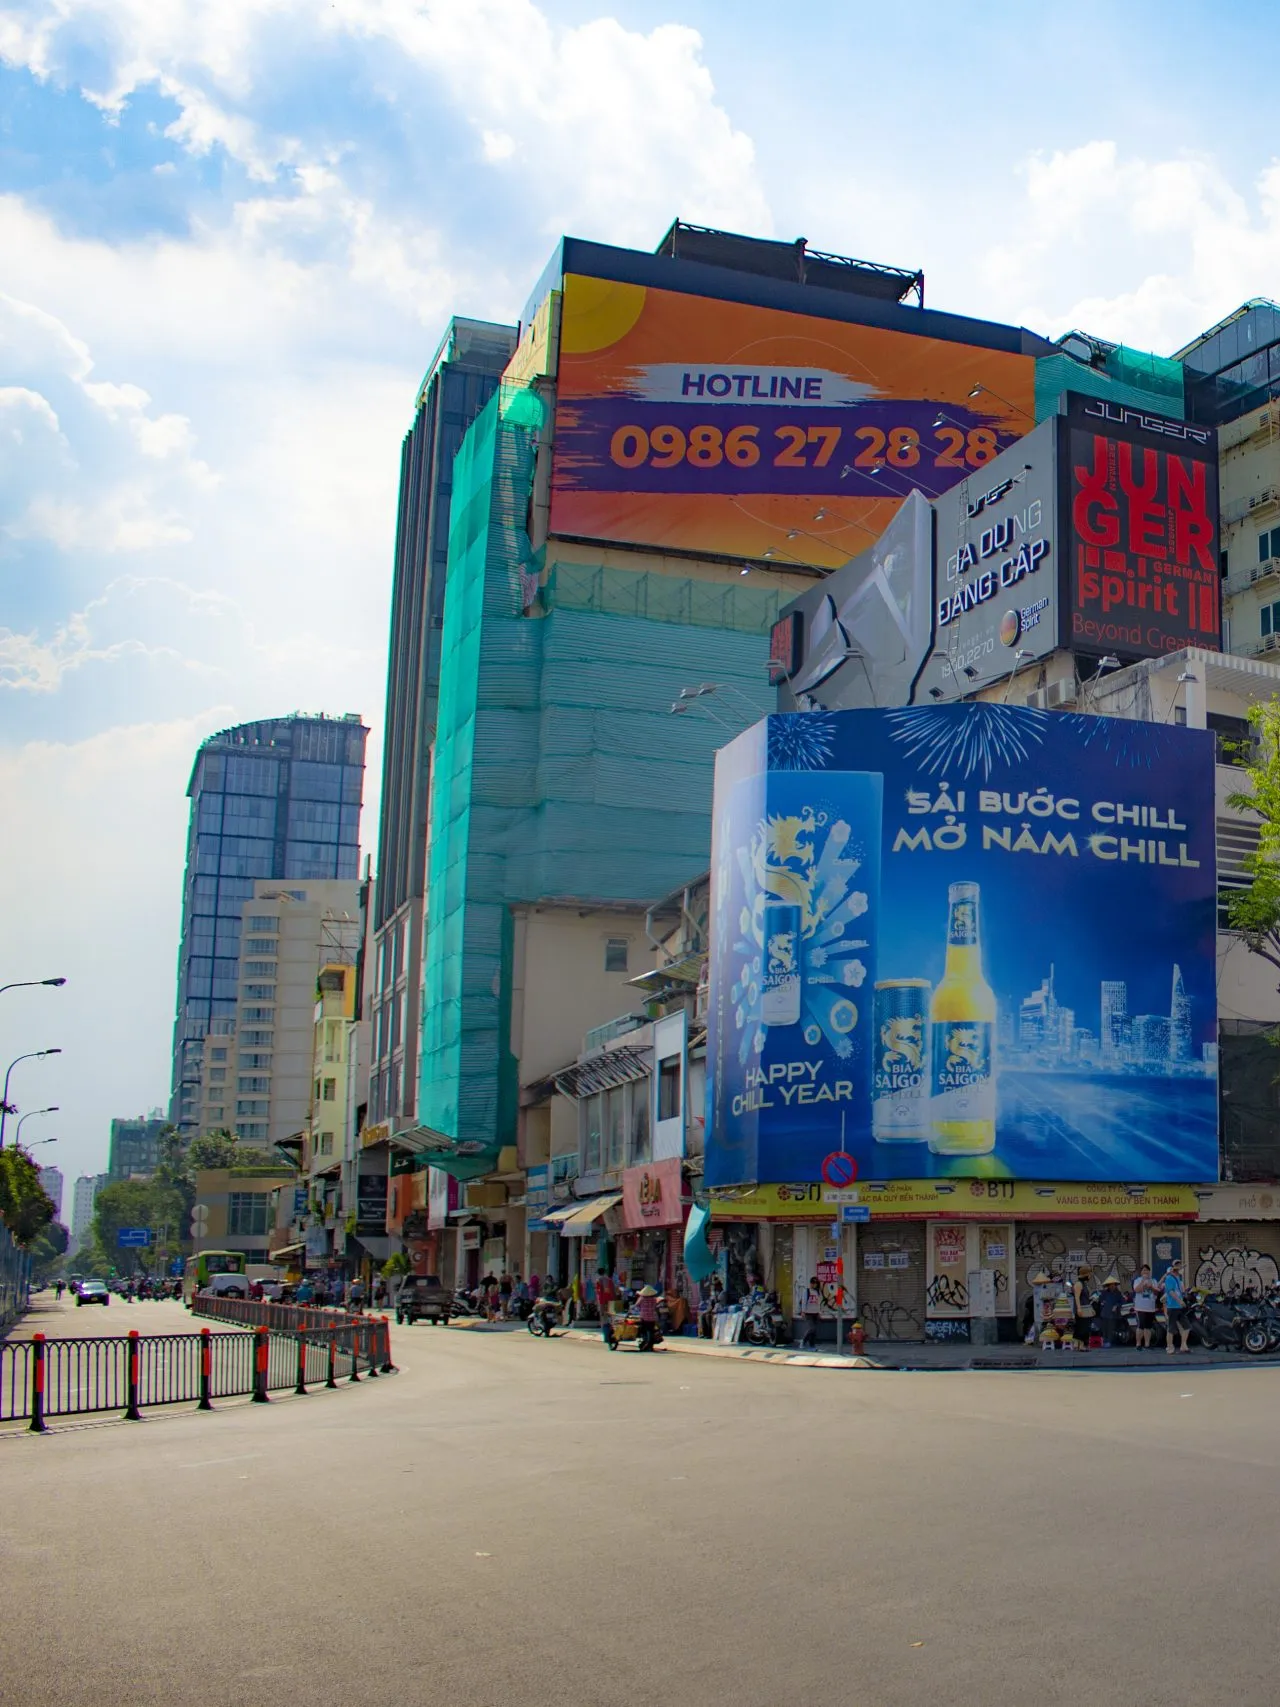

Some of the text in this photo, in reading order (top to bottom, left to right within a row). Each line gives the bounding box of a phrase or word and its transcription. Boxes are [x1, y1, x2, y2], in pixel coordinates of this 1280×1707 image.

[681, 371, 823, 400] HOTLINE
[609, 424, 998, 470] 0986 27 28 28
[1073, 434, 1207, 514] JUN
[947, 499, 1042, 584] GIA DỤNG
[1072, 487, 1219, 572] GER
[1000, 535, 1046, 588] CẤP
[1153, 560, 1214, 585] GERMAN
[1082, 567, 1179, 617] spirit
[1020, 597, 1049, 622] German
[1020, 611, 1041, 632] Spirit
[1072, 612, 1142, 645] Beyond
[907, 781, 1187, 831] SẢI BƯỚC CHILL
[892, 815, 1201, 869] MỞ NĂM CHILL
[745, 1059, 824, 1089] HAPPY
[891, 1064, 913, 1074] BIA
[938, 1072, 990, 1087] SAIGON
[954, 1064, 973, 1074] BIA
[732, 1079, 854, 1117] CHILL YEAR
[987, 1180, 1015, 1199] BTJ
